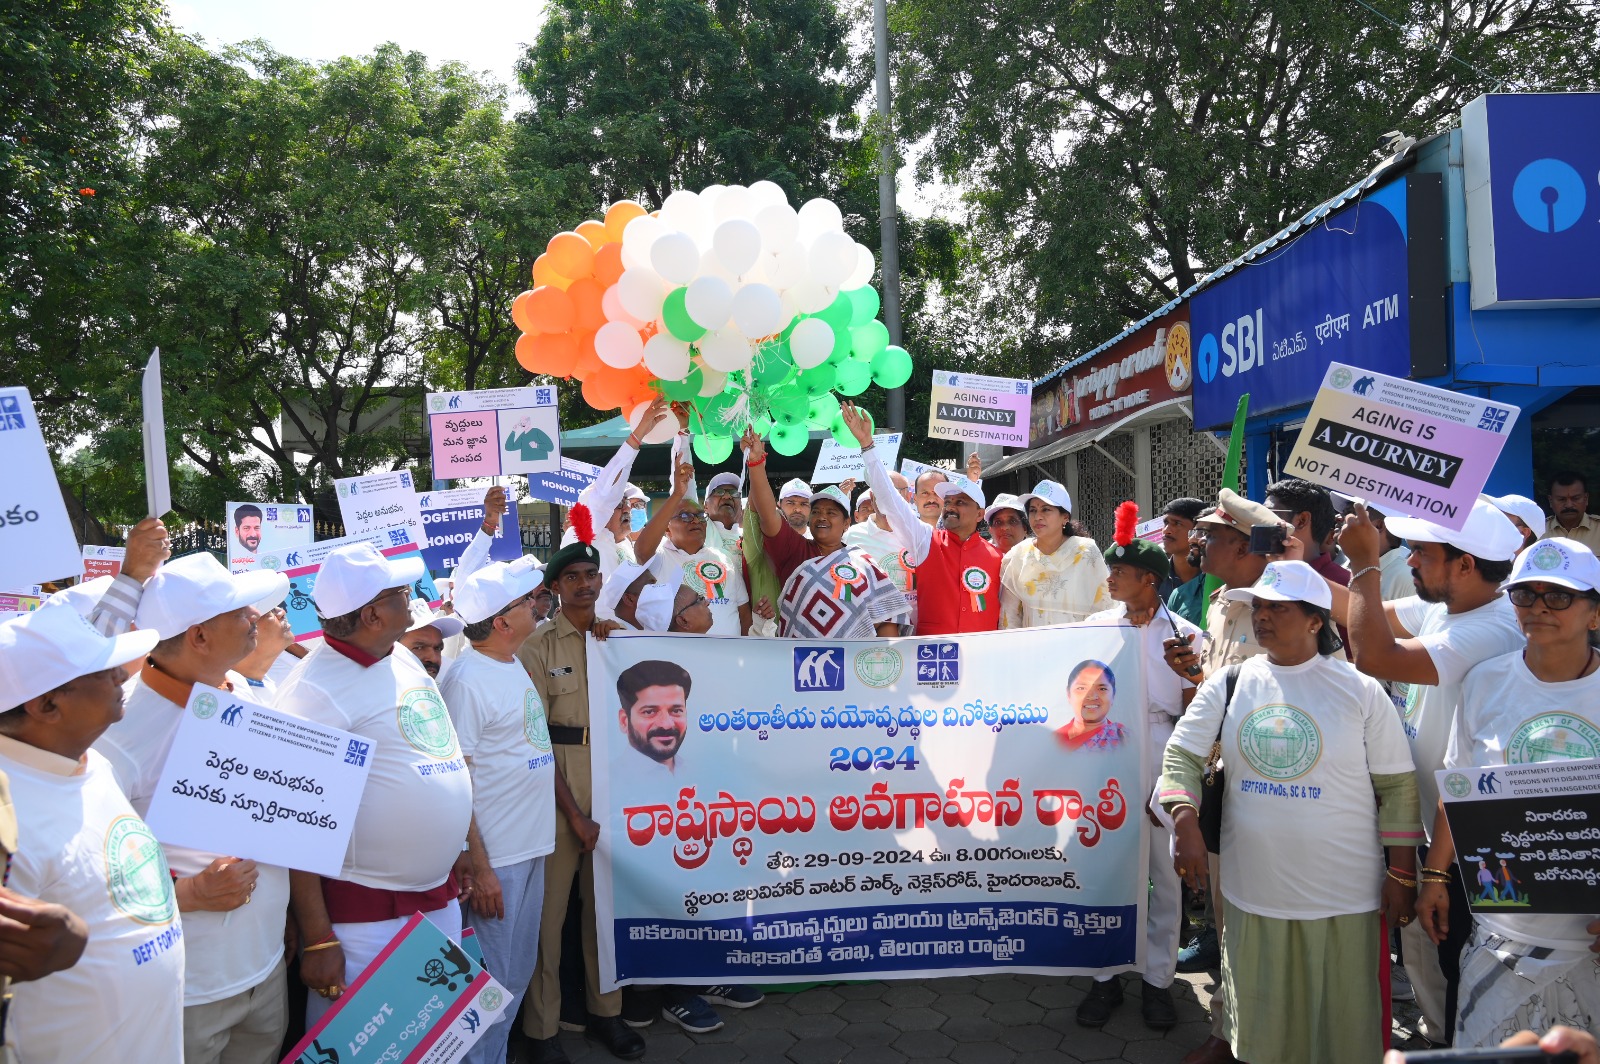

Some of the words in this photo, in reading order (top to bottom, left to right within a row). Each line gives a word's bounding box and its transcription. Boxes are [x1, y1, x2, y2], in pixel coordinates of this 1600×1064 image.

[1362, 294, 1398, 329] ATM
[1222, 308, 1264, 377] SBI
[1315, 314, 1350, 345] एटीएम
[954, 393, 986, 403] AGING
[989, 396, 998, 404] IS
[1382, 390, 1404, 399] PERSONS
[1451, 406, 1470, 415] SENIOR
[1384, 382, 1416, 394] DEPARTMENT
[1427, 393, 1467, 407] EMPOWERMENT
[939, 406, 947, 416] A
[951, 407, 1014, 422] JOURNEY
[1352, 407, 1414, 434] AGING
[1417, 423, 1437, 440] IS
[1380, 397, 1400, 405] CITIZENS
[1405, 404, 1441, 417] TRANSGENDER
[1442, 413, 1466, 423] PERSONS
[443, 437, 464, 446] మన
[467, 435, 487, 449] జ్ఞాన
[933, 426, 952, 434] NOT
[962, 429, 1023, 441] DESTINATION
[451, 453, 482, 463] సంపద
[1315, 426, 1331, 444] A
[1336, 431, 1456, 479] JOURNEY
[542, 480, 575, 494] HONOR
[1294, 456, 1329, 476] NOT
[1329, 468, 1340, 481] A
[1344, 472, 1458, 518] DESTINATION
[427, 533, 473, 547] HONOR
[251, 720, 273, 730] PERSONS
[253, 712, 285, 725] DEPARTMENT
[297, 726, 333, 739] EMPOWERMENT
[698, 703, 816, 740] అంతర్జాతీయ
[820, 705, 937, 740] వయోవృద్ధుల
[942, 699, 1048, 733] దినోత్సవము
[1243, 709, 1274, 737] GOVERNMENT
[1291, 712, 1316, 742] TELANGANA
[1512, 717, 1554, 749] GOVERNMENT
[249, 728, 271, 738] CITIZENS
[278, 736, 312, 750] TRANSGENDER
[313, 747, 334, 756] PERSONS
[206, 750, 248, 780] పెద్దల
[829, 745, 919, 772] 2024
[1505, 767, 1550, 776] DEPARTMENT
[1241, 780, 1255, 793] DEPT
[1255, 781, 1267, 794] FOR
[1269, 783, 1289, 799] PwDs,
[1290, 785, 1299, 798] SC
[1302, 786, 1306, 798] &
[1308, 787, 1321, 799] TGP
[172, 779, 226, 804] మనకు
[230, 793, 337, 830] స్ఫూర్తిదాయకం
[1525, 809, 1588, 823] నిరాదరణ
[622, 786, 816, 870] రాష్ట్రస్థాయి
[829, 776, 1023, 831] అవగాహన
[1033, 778, 1126, 847] ర్యాలీ
[804, 849, 924, 868] 29-09-2024
[1520, 850, 1546, 862] వారి
[684, 891, 728, 916] స్థలం:
[733, 878, 805, 902] జలవిహార్
[809, 875, 856, 895] వాటర్
[986, 871, 1080, 892] హైదరాబాద్.
[629, 925, 748, 943] వికలాంగులు,
[753, 915, 868, 944] వయోవృద్ధులు
[872, 911, 943, 930] మరియు
[1063, 911, 1122, 936] వ్యక్తుల
[132, 938, 159, 966] DEPT
[156, 928, 175, 952] FOR
[726, 946, 822, 966] సాధికారత
[827, 944, 874, 962] శాఖ,
[879, 939, 965, 957] తెలంగాణ
[968, 935, 1025, 960] రాష్ట్రం
[348, 1002, 394, 1056] 14567
[399, 994, 444, 1041] మీకోసం
[434, 1031, 453, 1053] CITIZENS
[438, 1036, 459, 1058] PERSONS
